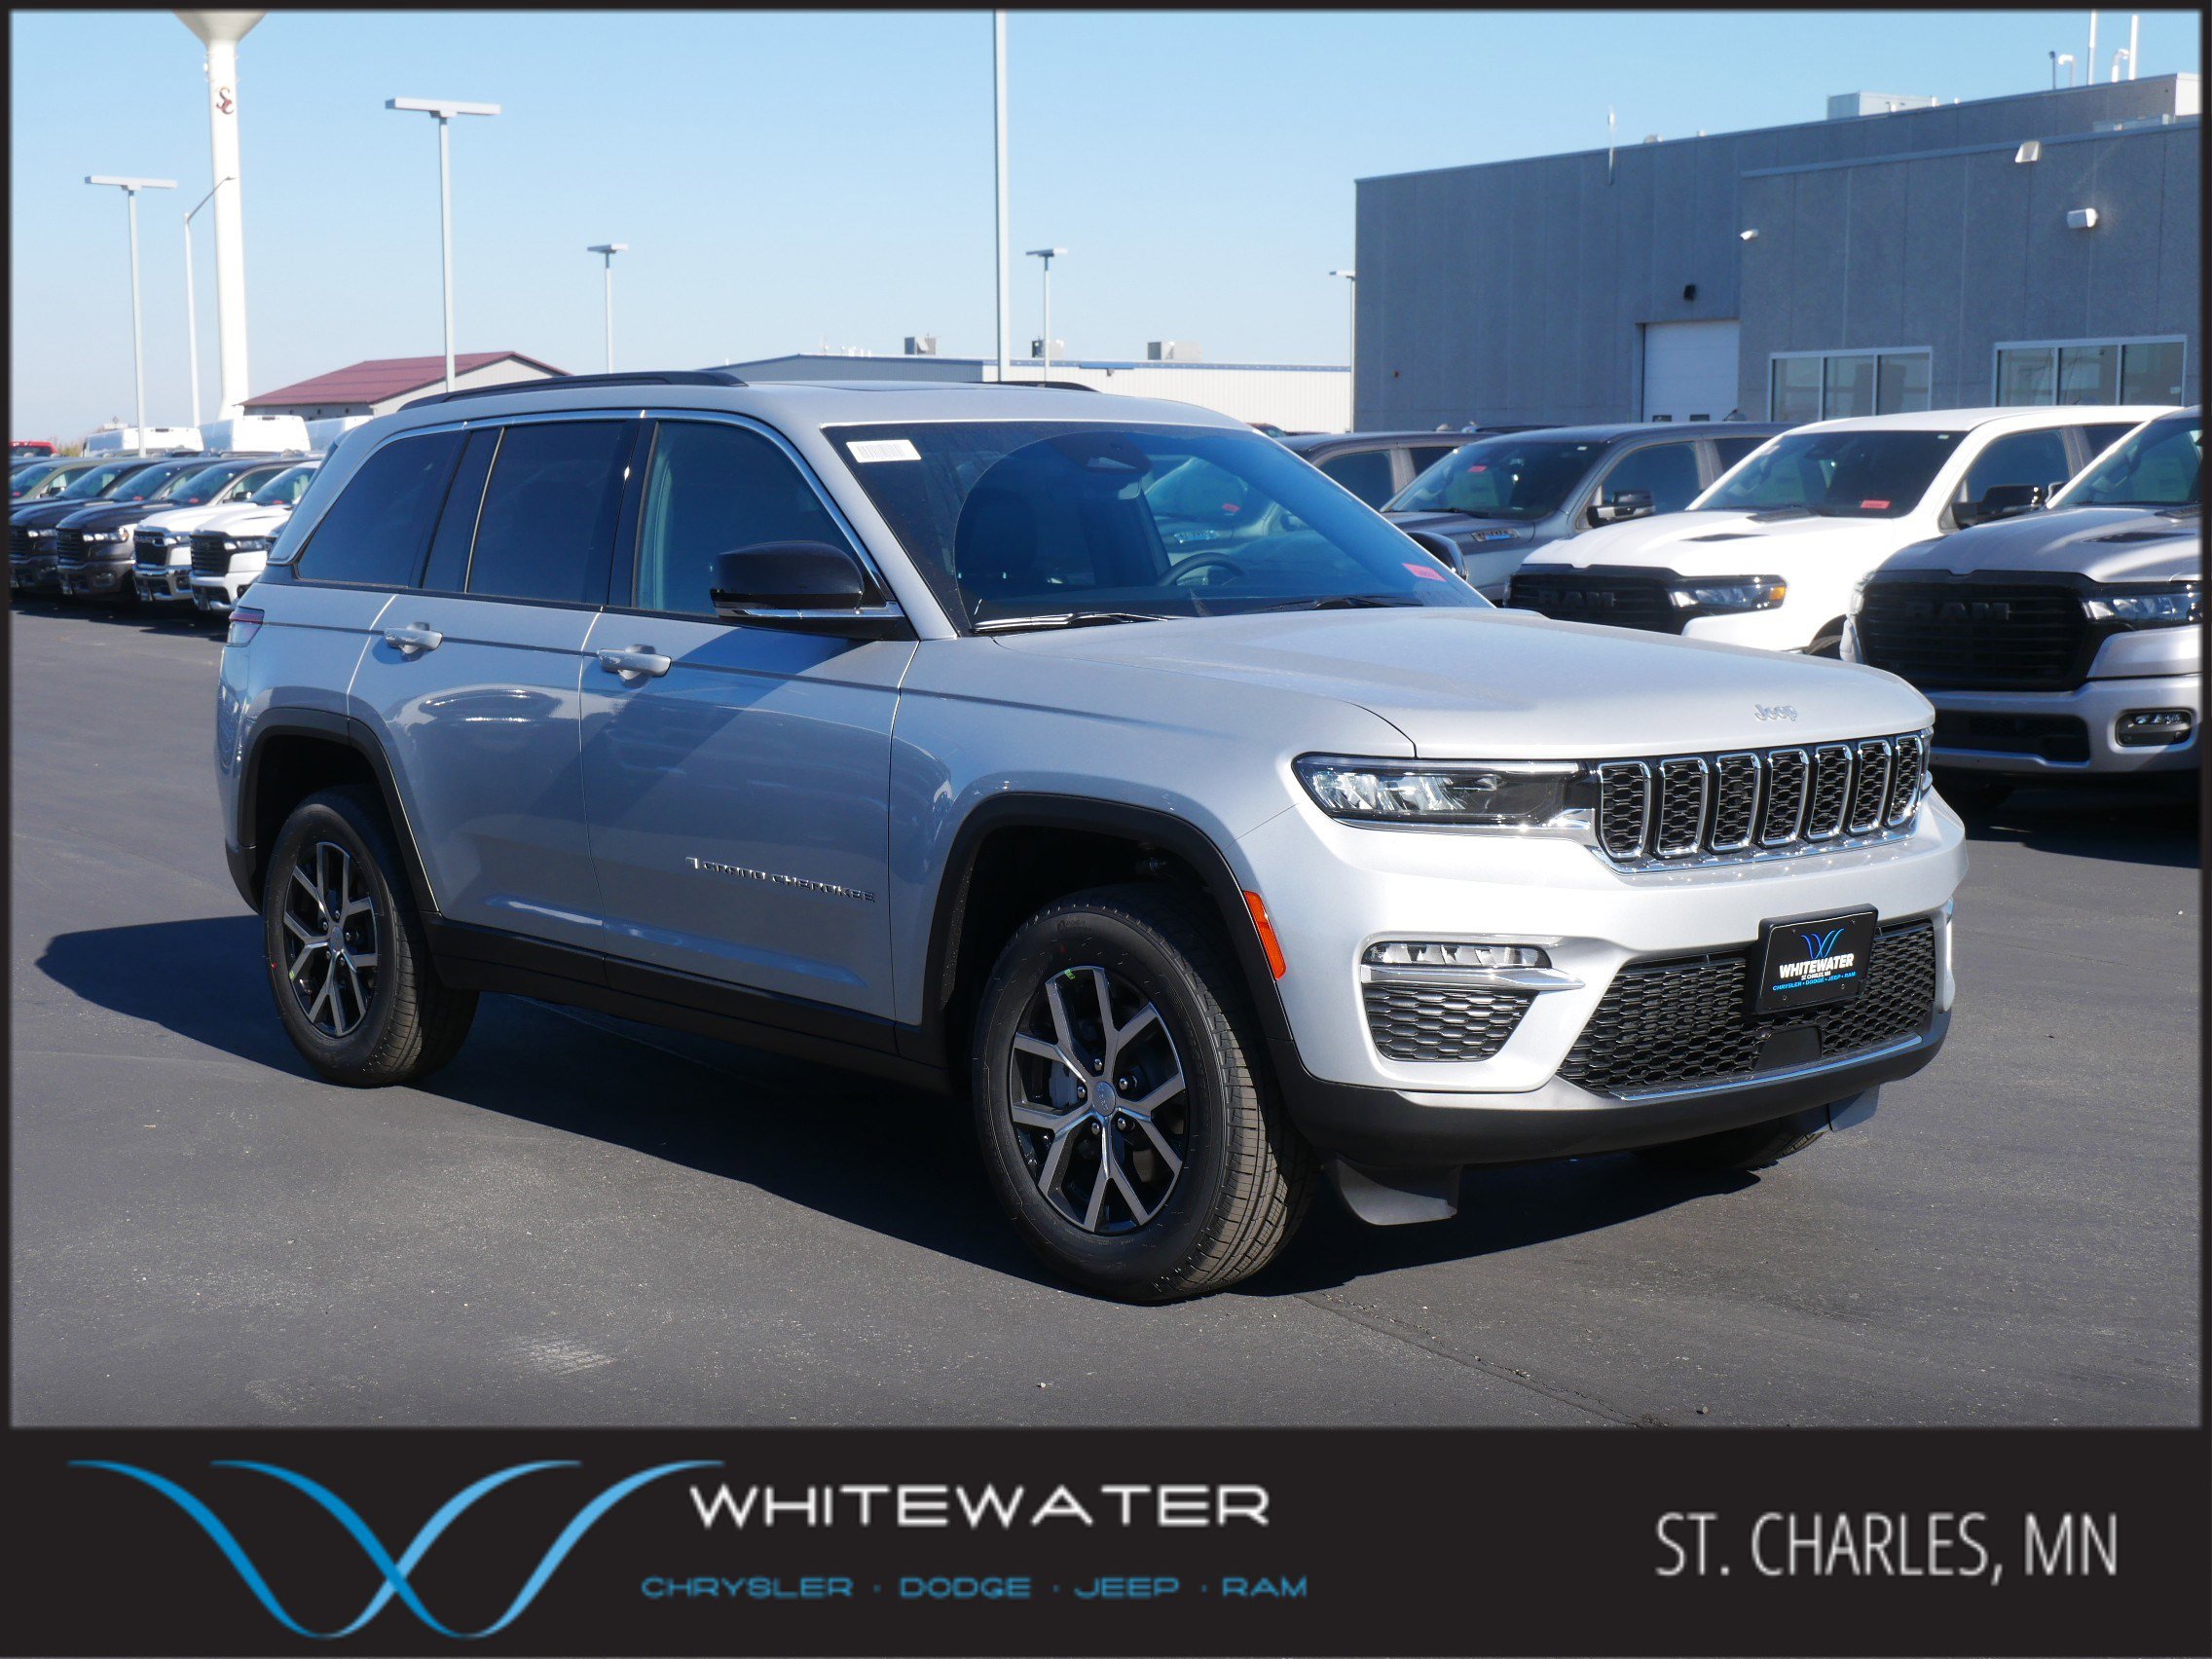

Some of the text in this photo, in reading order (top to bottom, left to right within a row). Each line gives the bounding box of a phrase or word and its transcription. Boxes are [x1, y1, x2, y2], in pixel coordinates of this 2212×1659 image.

[1753, 703, 1798, 722] Jeep
[771, 873, 876, 903] CHEROKEE
[1779, 952, 1855, 979] WHITEWATER
[1772, 979, 1802, 991] CHRYSLER
[1805, 977, 1825, 986] DODGE
